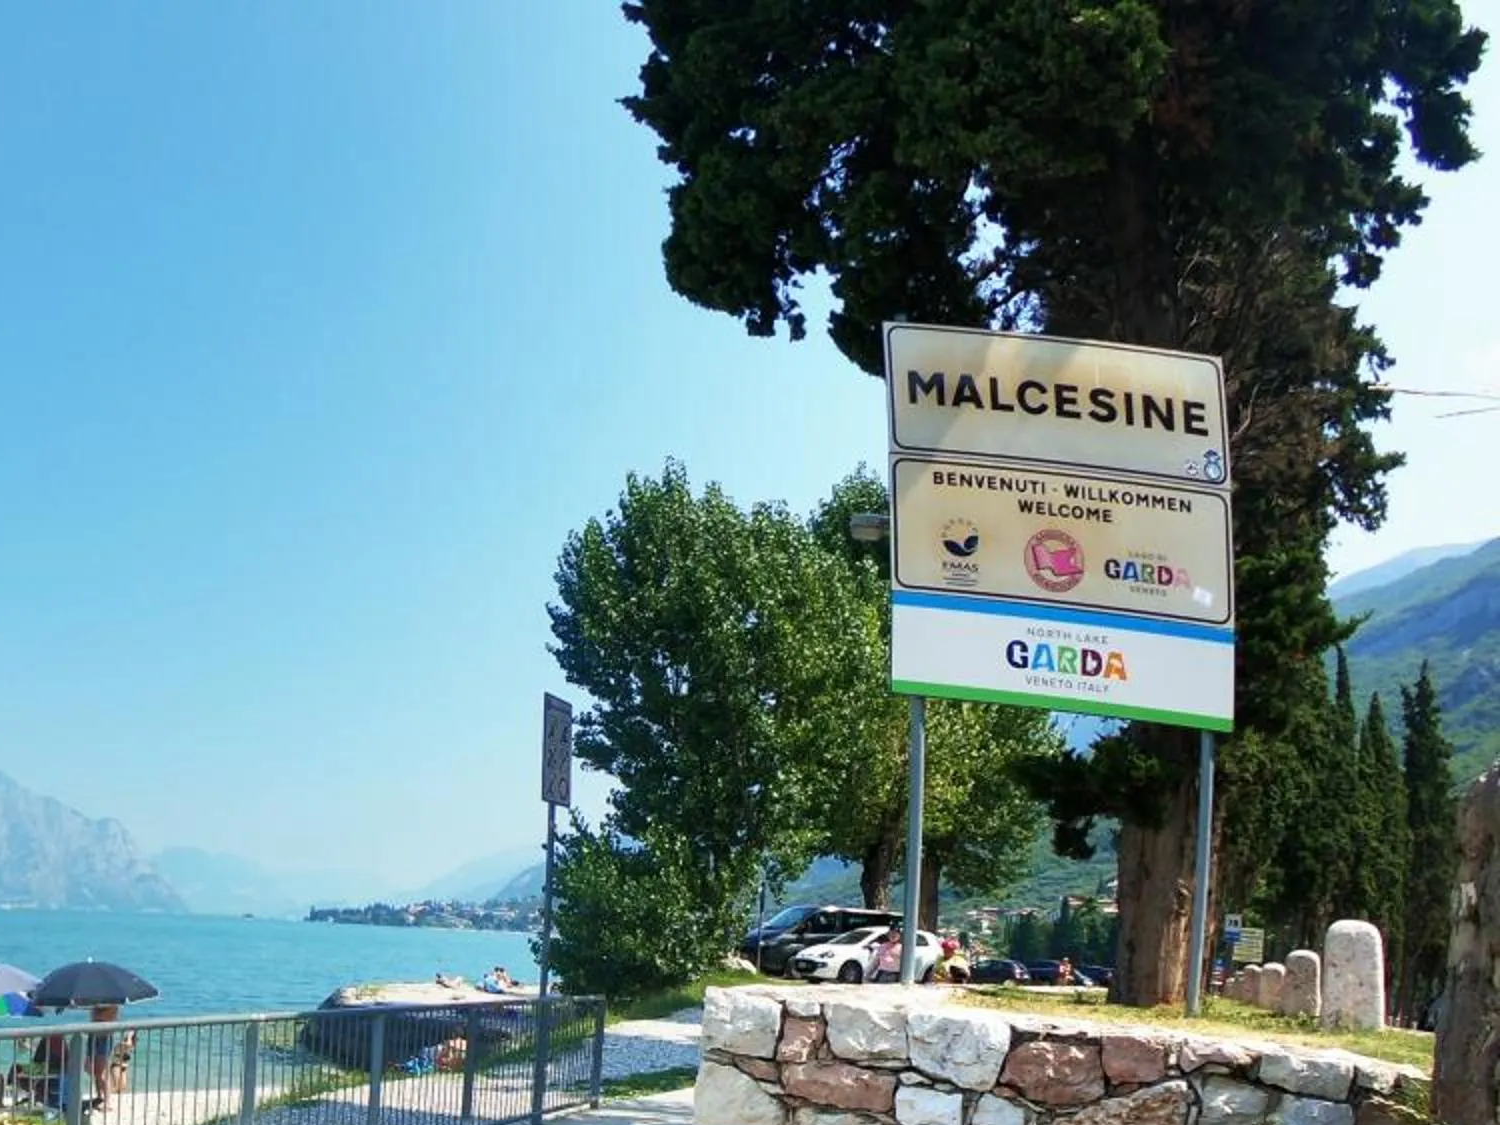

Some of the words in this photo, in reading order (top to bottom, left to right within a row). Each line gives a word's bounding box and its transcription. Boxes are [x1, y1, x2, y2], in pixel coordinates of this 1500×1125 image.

[907, 369, 1210, 437] MALCESINE
[933, 471, 1046, 496] BENVENUTI
[1063, 484, 1193, 514] WILLKOMMEN
[1017, 498, 1113, 523] WELCOME
[1104, 558, 1191, 588] GARDA
[1027, 627, 1072, 640] NORTH
[1075, 632, 1109, 645] LAKE
[1006, 639, 1128, 681] GARDA
[1025, 675, 1073, 690] VENETO
[1077, 680, 1110, 693] ITALY
